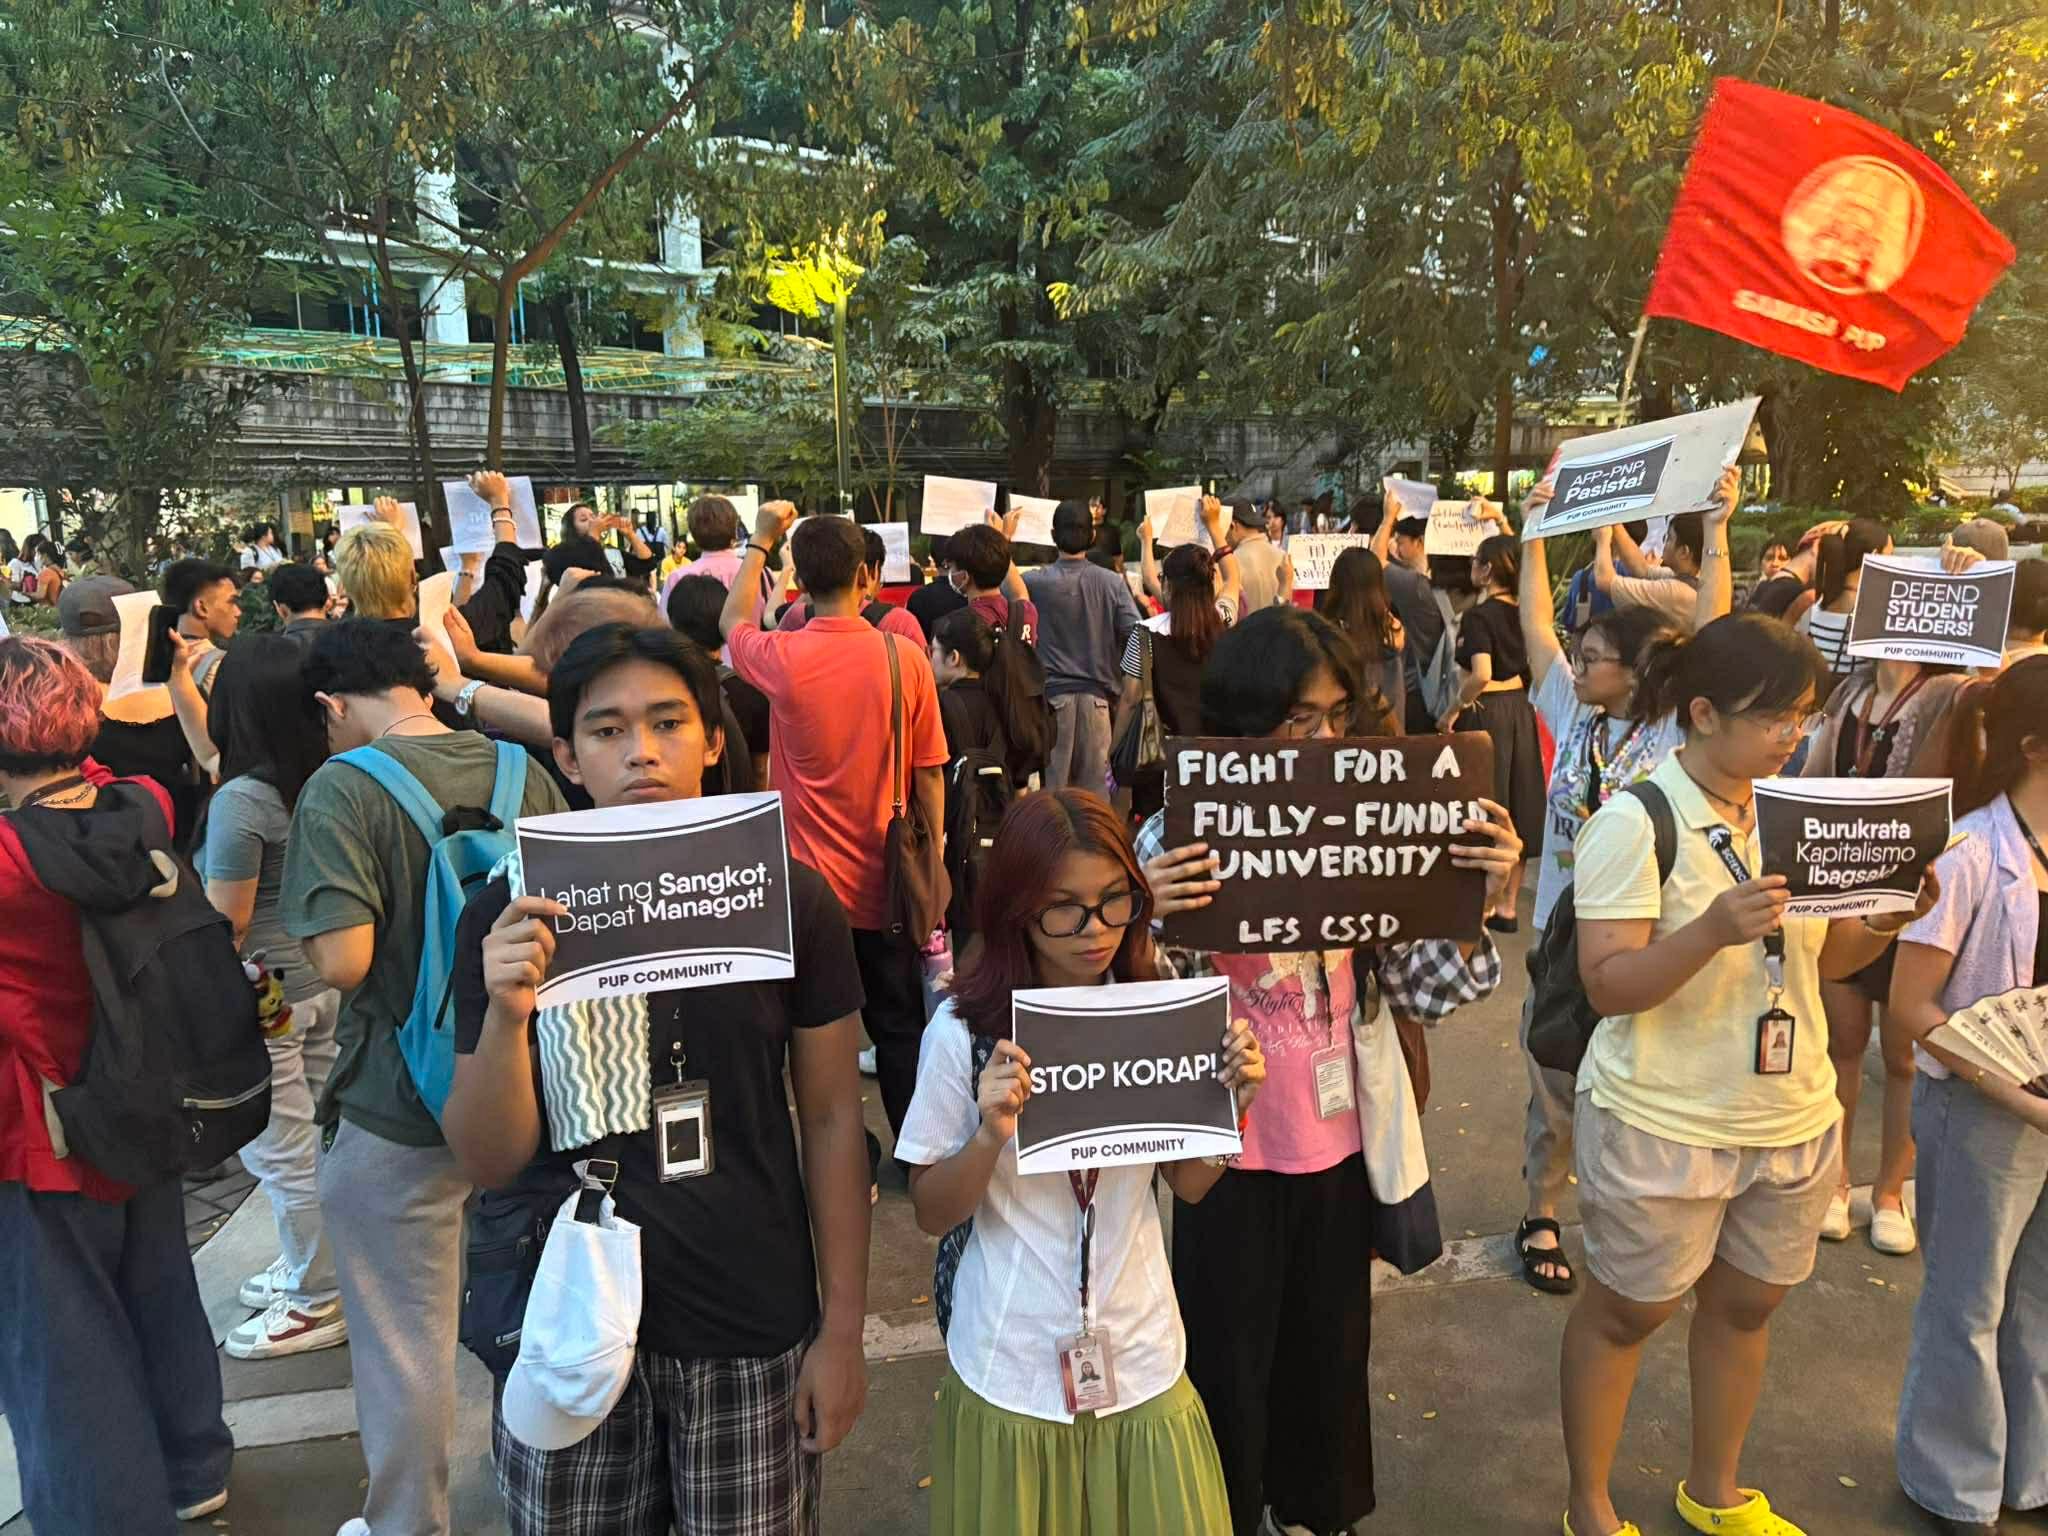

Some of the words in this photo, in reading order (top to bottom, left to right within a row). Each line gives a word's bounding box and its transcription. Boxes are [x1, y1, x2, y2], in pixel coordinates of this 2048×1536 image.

[1564, 470, 1646, 504] Pasista!
[1890, 580, 1980, 604] DEFEND
[1887, 600, 1978, 621] STUDENT
[1884, 616, 1974, 637] LEADERS!
[1884, 646, 1903, 655] PUP
[1905, 647, 1965, 661] COMMUNITY
[1177, 748, 1299, 786] FIGHT
[1333, 747, 1407, 784] FOR
[1431, 744, 1462, 779] A
[1803, 817, 1911, 840] Burukrata
[1208, 844, 1441, 881] UNIVERSITY
[1796, 841, 1916, 867] Kapitalismo
[618, 880, 653, 905] ng
[658, 862, 773, 897] Sangkot,
[554, 904, 636, 935] Dapat
[642, 886, 765, 925] Managot!
[1787, 903, 1812, 913] PUP
[1813, 898, 1879, 914] COMMUNITY
[1239, 916, 1301, 945] LFS
[1320, 912, 1400, 943] CSSD
[598, 974, 630, 989] PUP
[634, 960, 734, 985] COMMUNITY
[1030, 1062, 1106, 1094] STOP
[1113, 1053, 1217, 1088] KORAP!
[1071, 1146, 1098, 1160] PUP
[1101, 1137, 1186, 1157] COMMUNITY
